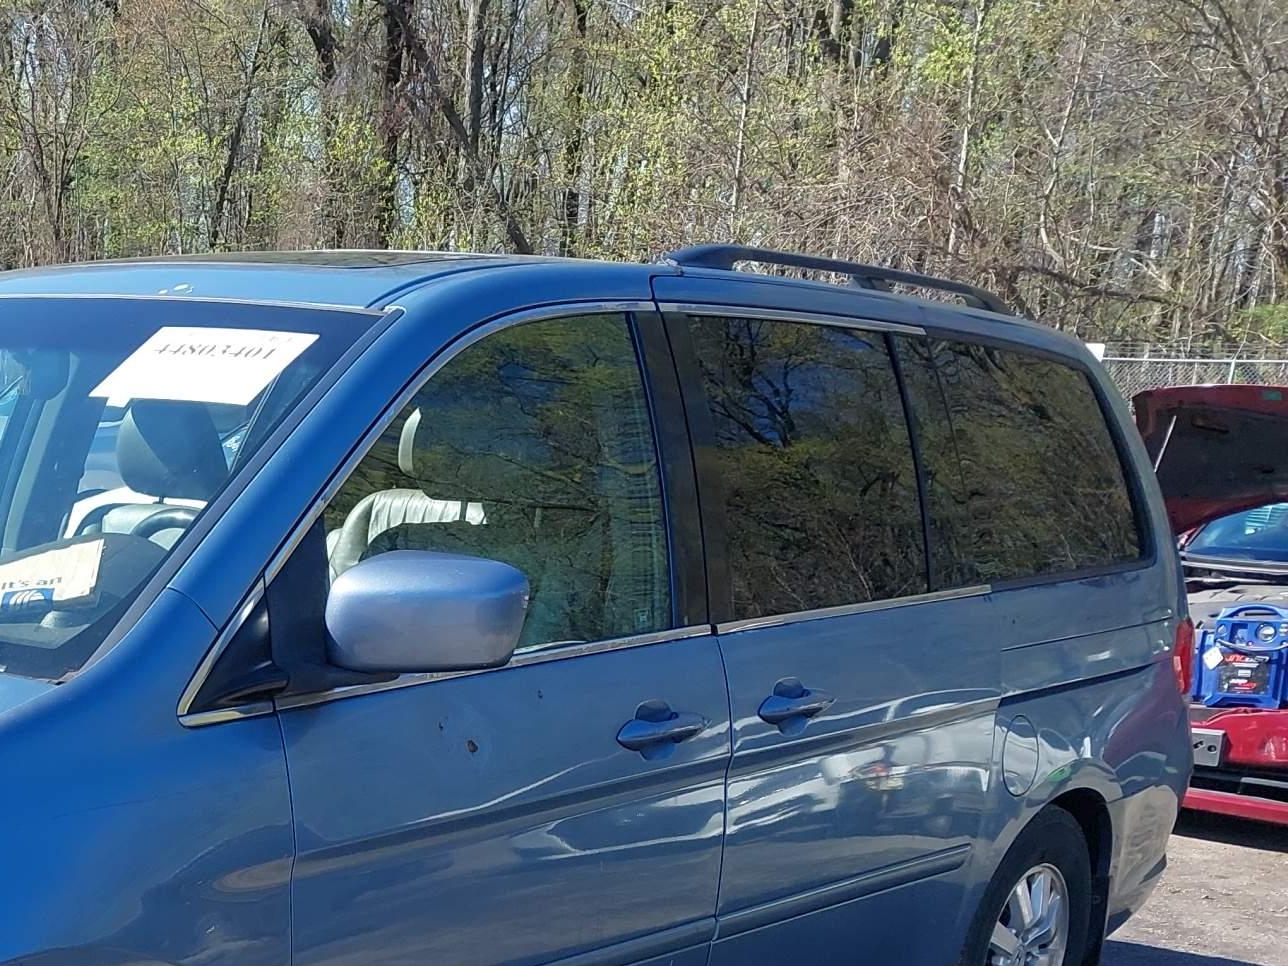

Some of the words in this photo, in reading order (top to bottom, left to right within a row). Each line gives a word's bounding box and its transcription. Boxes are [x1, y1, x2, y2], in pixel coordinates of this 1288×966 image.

[154, 342, 276, 360] 44803401
[1, 579, 32, 591] It's
[35, 576, 63, 586] an
